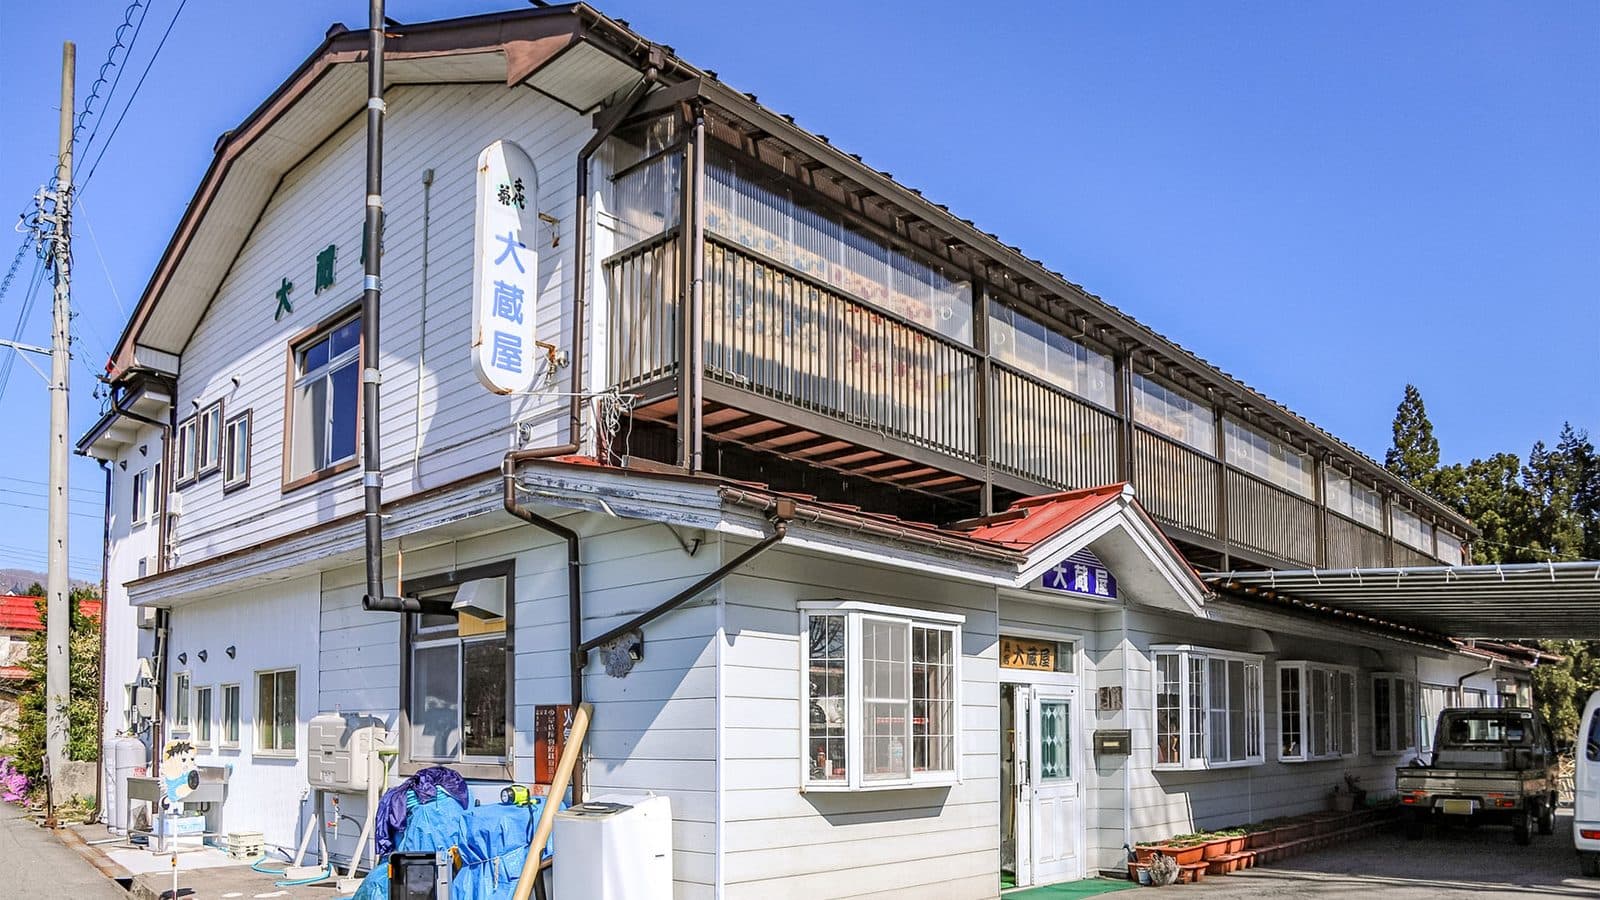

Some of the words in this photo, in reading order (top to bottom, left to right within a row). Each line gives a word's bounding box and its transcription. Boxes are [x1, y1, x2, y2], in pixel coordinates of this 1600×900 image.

[491, 231, 526, 374] 大蔵屋
[1053, 563, 1109, 596] 大蔵屋
[1012, 644, 1050, 668] 大蔵屋
